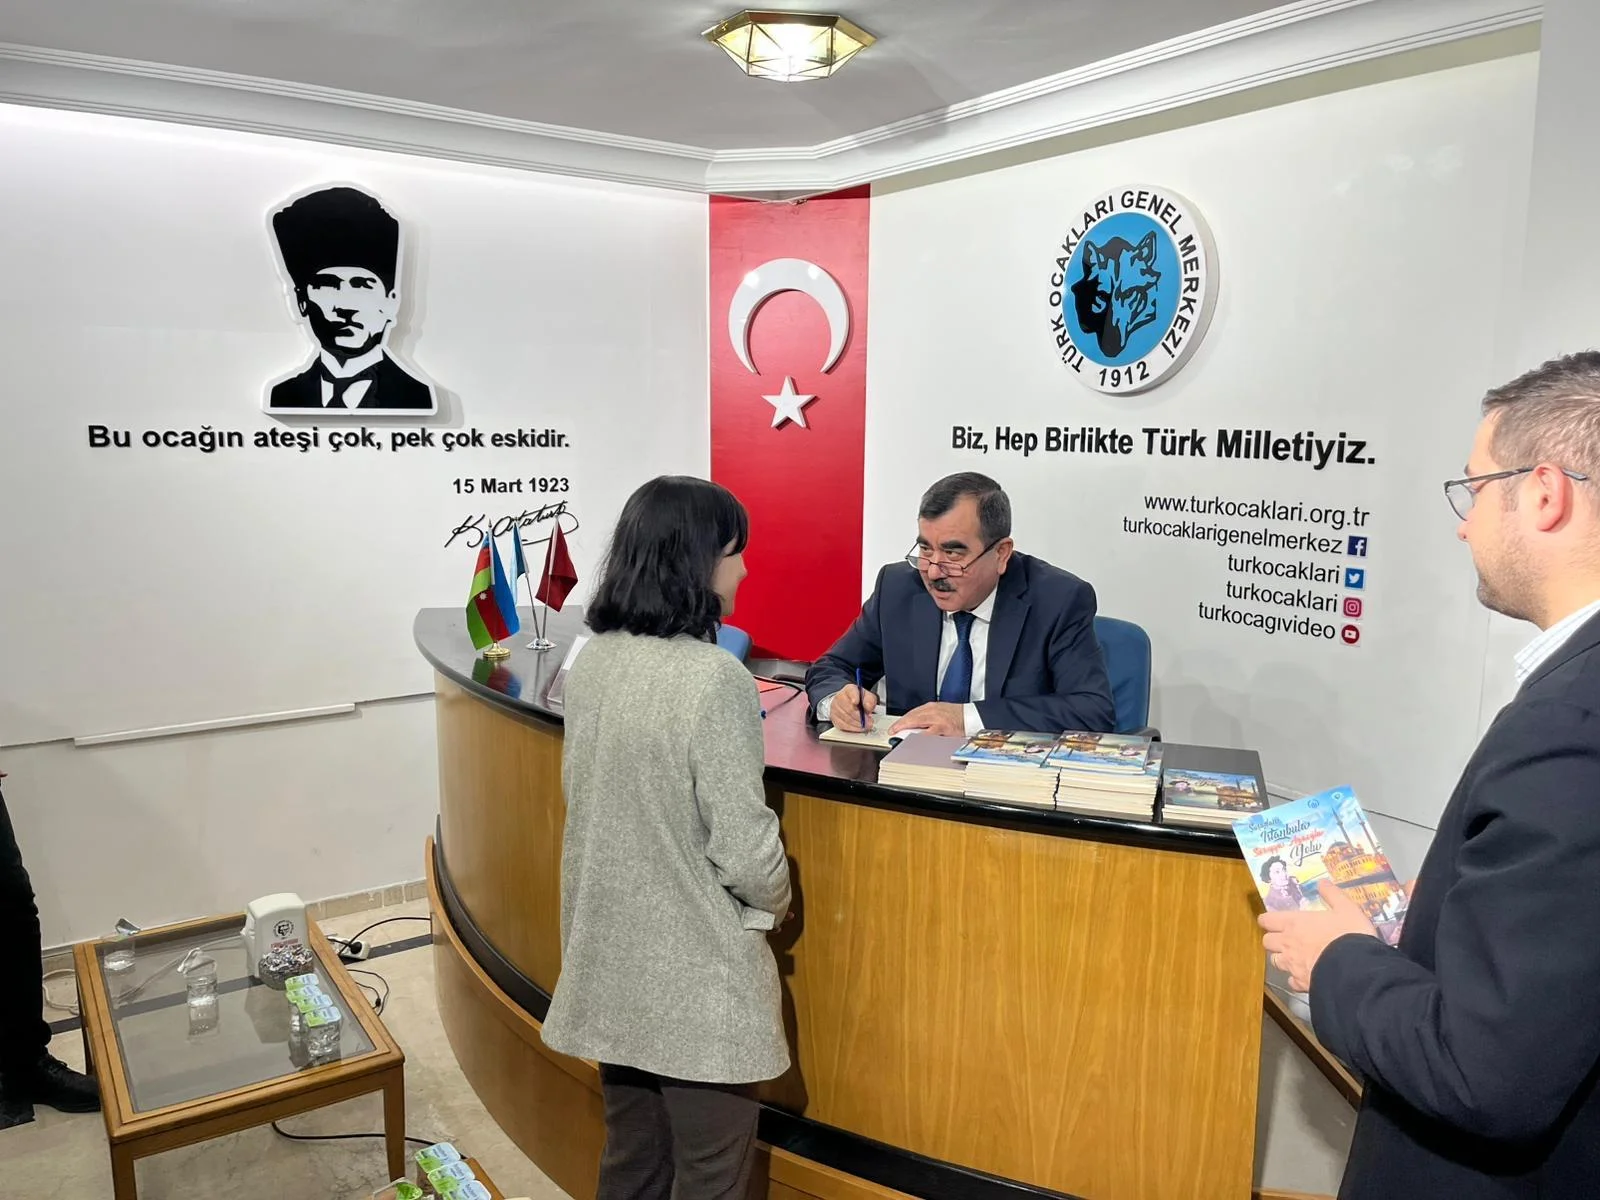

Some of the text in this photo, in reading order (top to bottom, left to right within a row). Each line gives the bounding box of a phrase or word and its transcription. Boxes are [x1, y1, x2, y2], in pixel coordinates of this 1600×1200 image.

[1049, 190, 1200, 373] TÜRK OCAKLARI GENEL MERKEZİ
[1098, 360, 1150, 388] 1912
[88, 425, 570, 453] Bu ocağın ateşi çok, pek çok eskidir.
[952, 426, 1376, 470] Biz, Hep Birlikte Türk Milletiyiz.
[453, 477, 570, 494] 15 Mart 1923
[1144, 495, 1371, 531] www.turkocaklari.org.tr
[1123, 516, 1343, 555] turkocaklarigenelmerkez
[1227, 554, 1340, 585] turkocaklari
[1226, 580, 1338, 613] turkocaklari
